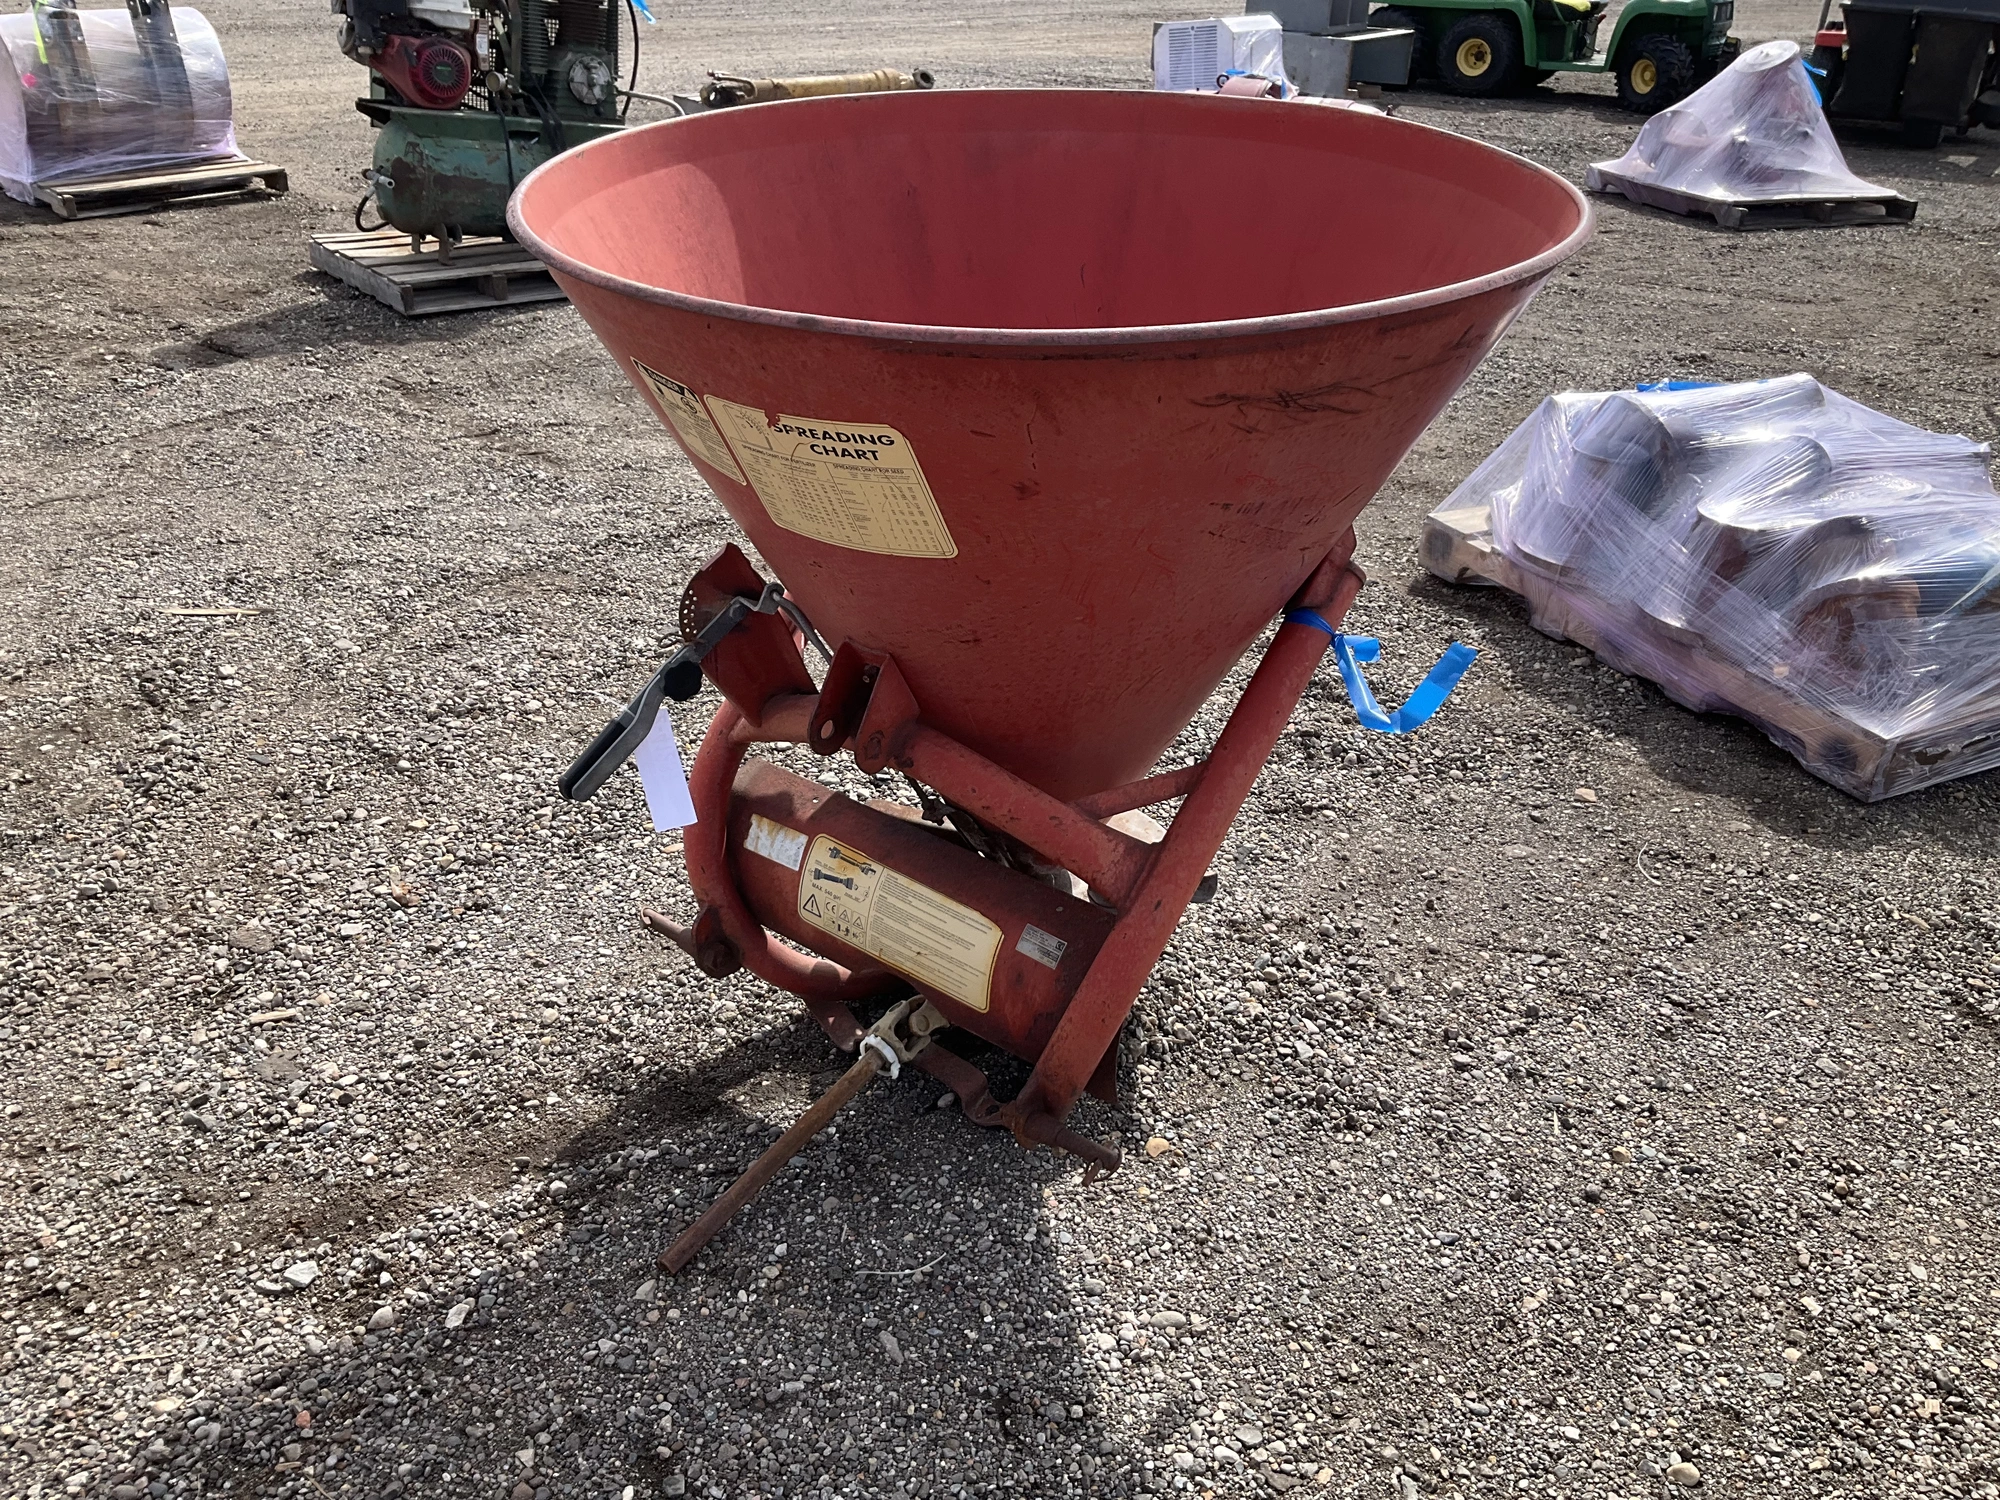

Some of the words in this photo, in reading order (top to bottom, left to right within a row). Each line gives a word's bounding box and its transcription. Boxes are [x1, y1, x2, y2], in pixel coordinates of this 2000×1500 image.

[774, 423, 895, 446] SPREADING
[810, 444, 879, 460] CHART
[833, 463, 860, 471] SPREADING
[811, 882, 823, 892] MAX.
[824, 889, 833, 897] 540
